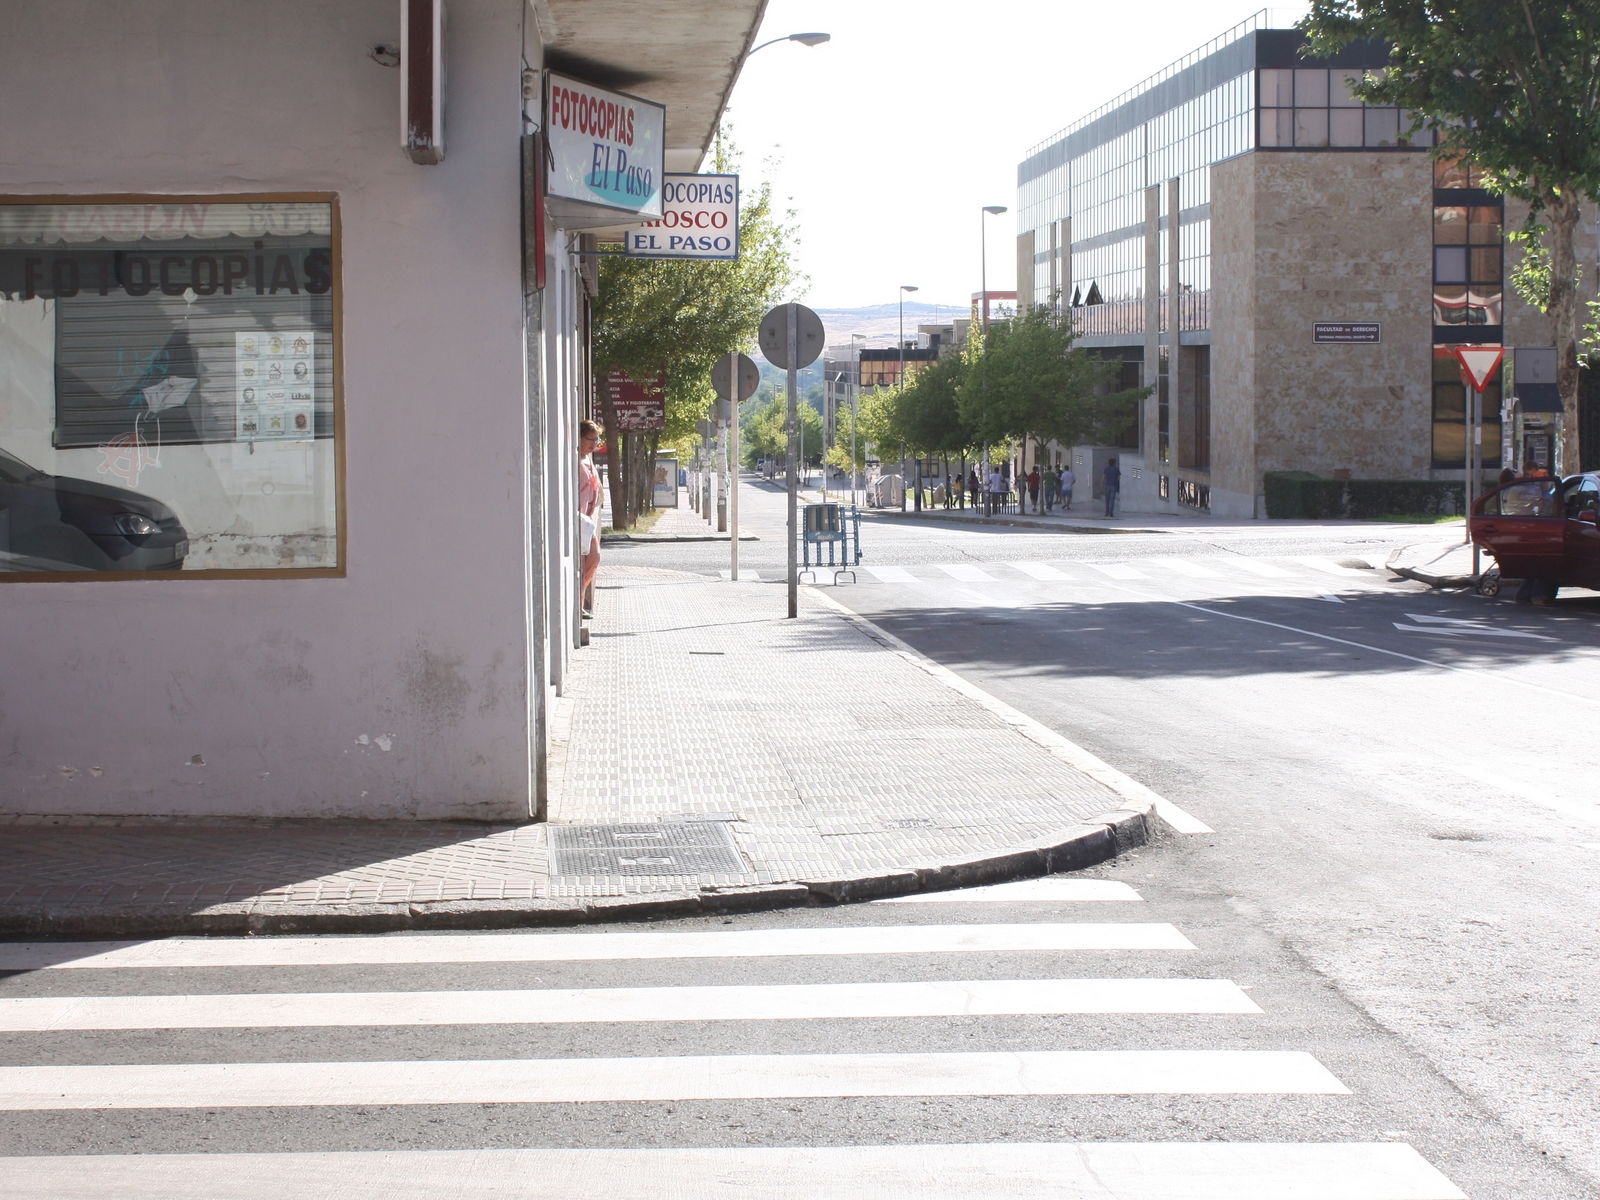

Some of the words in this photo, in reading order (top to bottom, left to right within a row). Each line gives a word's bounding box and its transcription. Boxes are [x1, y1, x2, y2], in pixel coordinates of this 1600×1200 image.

[552, 86, 634, 147] FOTOCOPIAS
[590, 142, 610, 190] El
[613, 148, 652, 198] Paso
[664, 182, 733, 204] OCOPIAS
[24, 241, 331, 299] FOTOCOPIAS
[634, 235, 661, 250] EL
[669, 235, 731, 251] PASO
